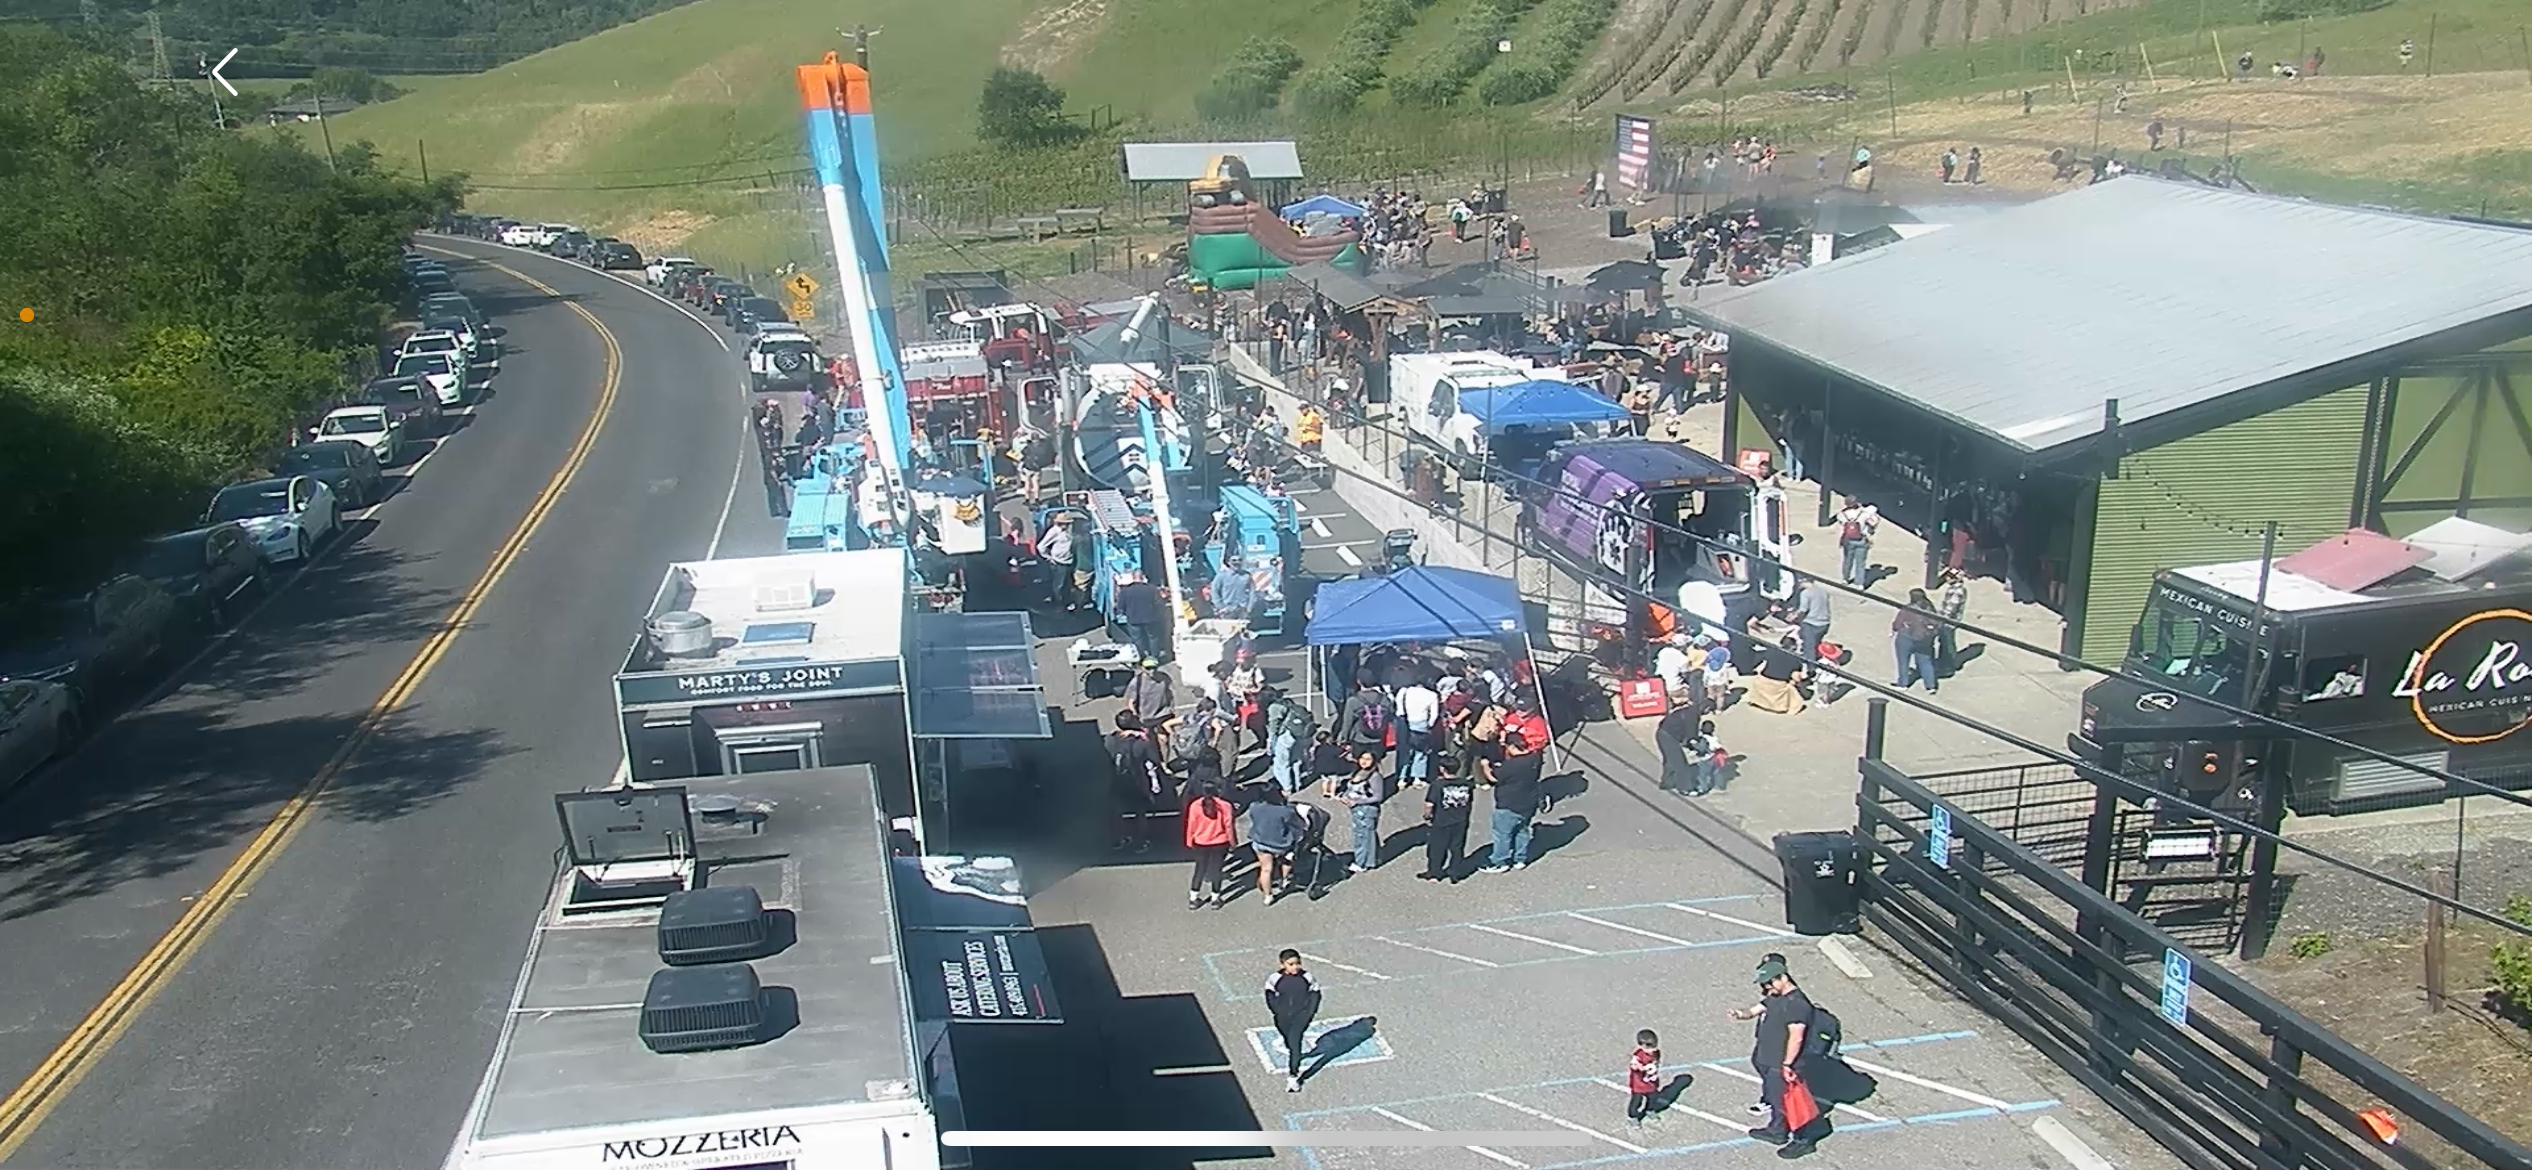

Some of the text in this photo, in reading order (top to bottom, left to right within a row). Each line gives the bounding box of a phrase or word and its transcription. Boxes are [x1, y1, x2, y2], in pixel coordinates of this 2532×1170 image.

[2160, 587, 2214, 614] MEXICAN
[2217, 609, 2269, 636] CUISIE
[678, 667, 843, 689] MARTY'S JOINT
[690, 686, 735, 695] COMFORT
[738, 684, 764, 692] FOOD
[766, 682, 785, 690] FOR
[2391, 650, 2456, 697] La
[2429, 695, 2531, 713] MEXICAN CUISN
[942, 961, 973, 1017] ASK US ABOUT
[964, 941, 1002, 1017] CATERING SERVICES
[602, 1125, 801, 1162] MOZZERIA
